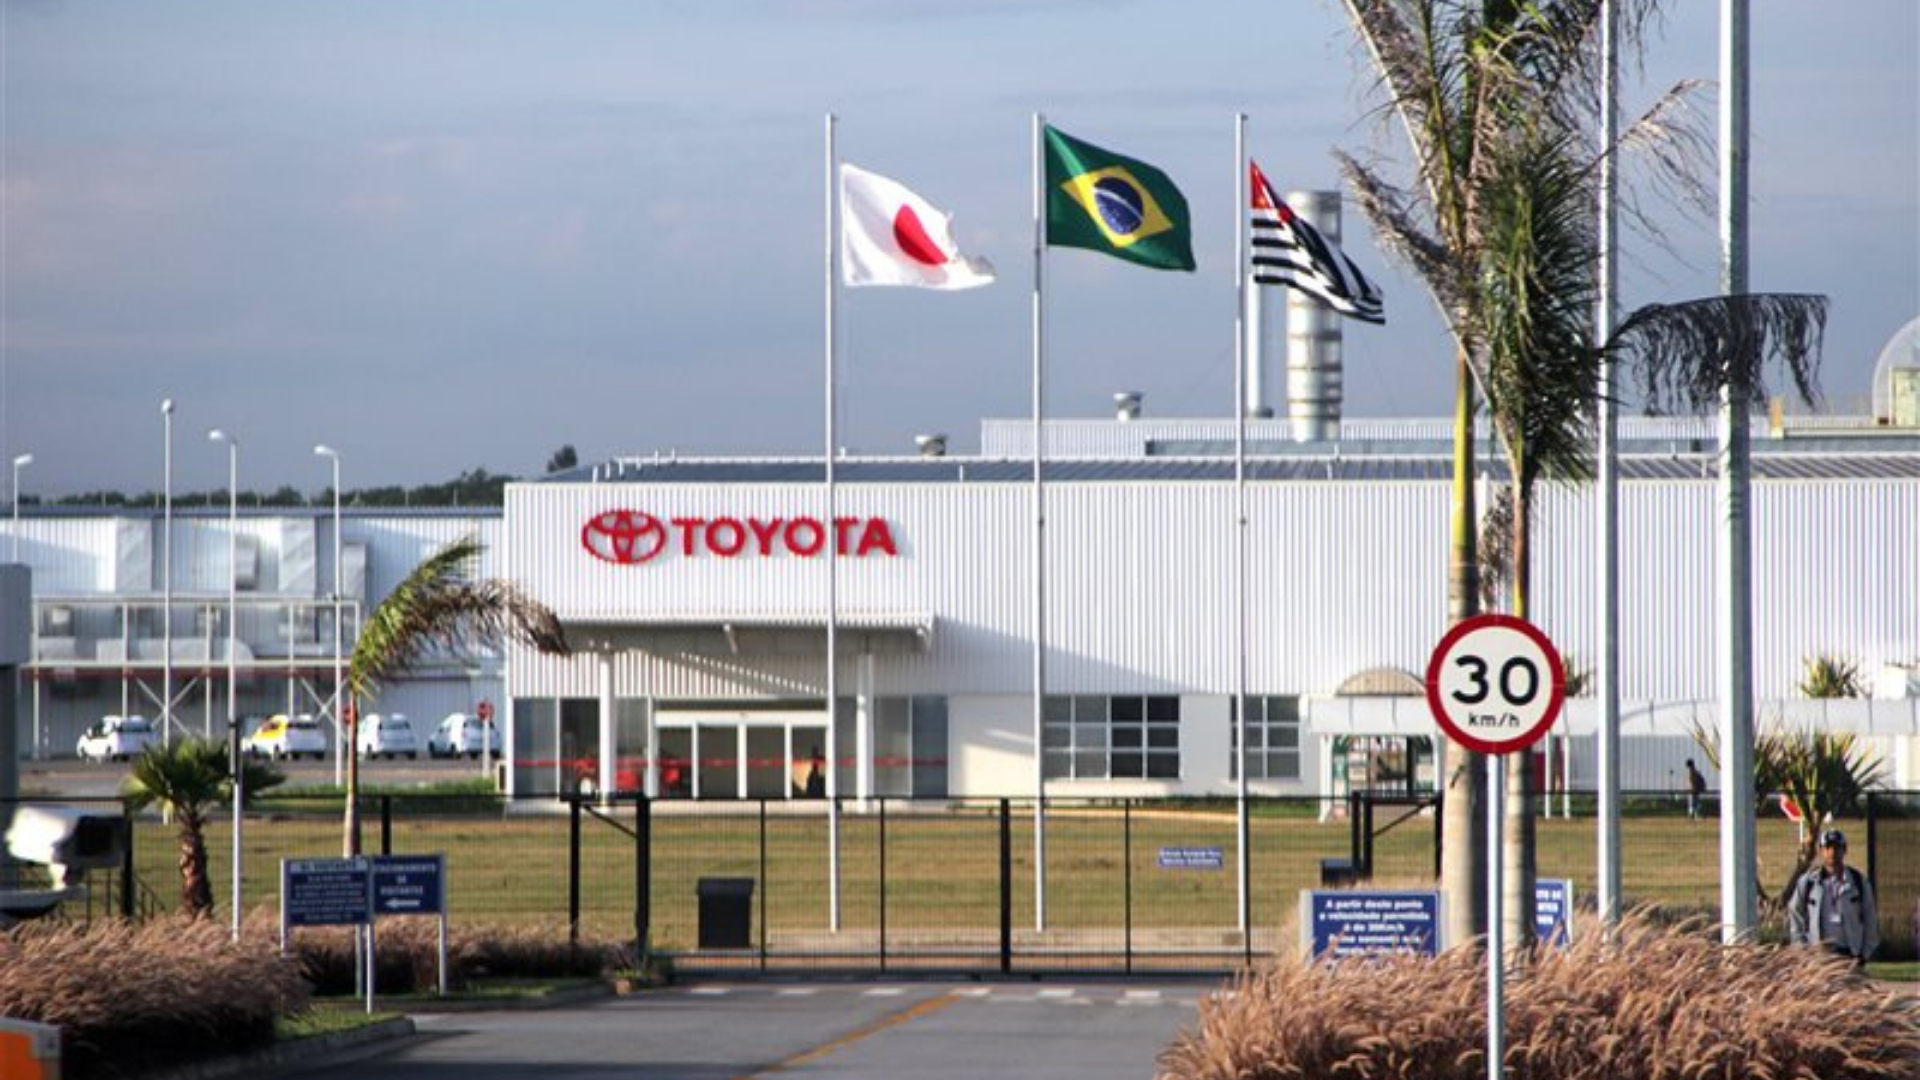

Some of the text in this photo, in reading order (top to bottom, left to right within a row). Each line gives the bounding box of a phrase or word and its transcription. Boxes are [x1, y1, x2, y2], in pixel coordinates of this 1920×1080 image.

[672, 517, 897, 557] TOYOTA
[1452, 655, 1539, 706] 30
[1468, 712, 1520, 727] km/h
[1326, 900, 1333, 909] A
